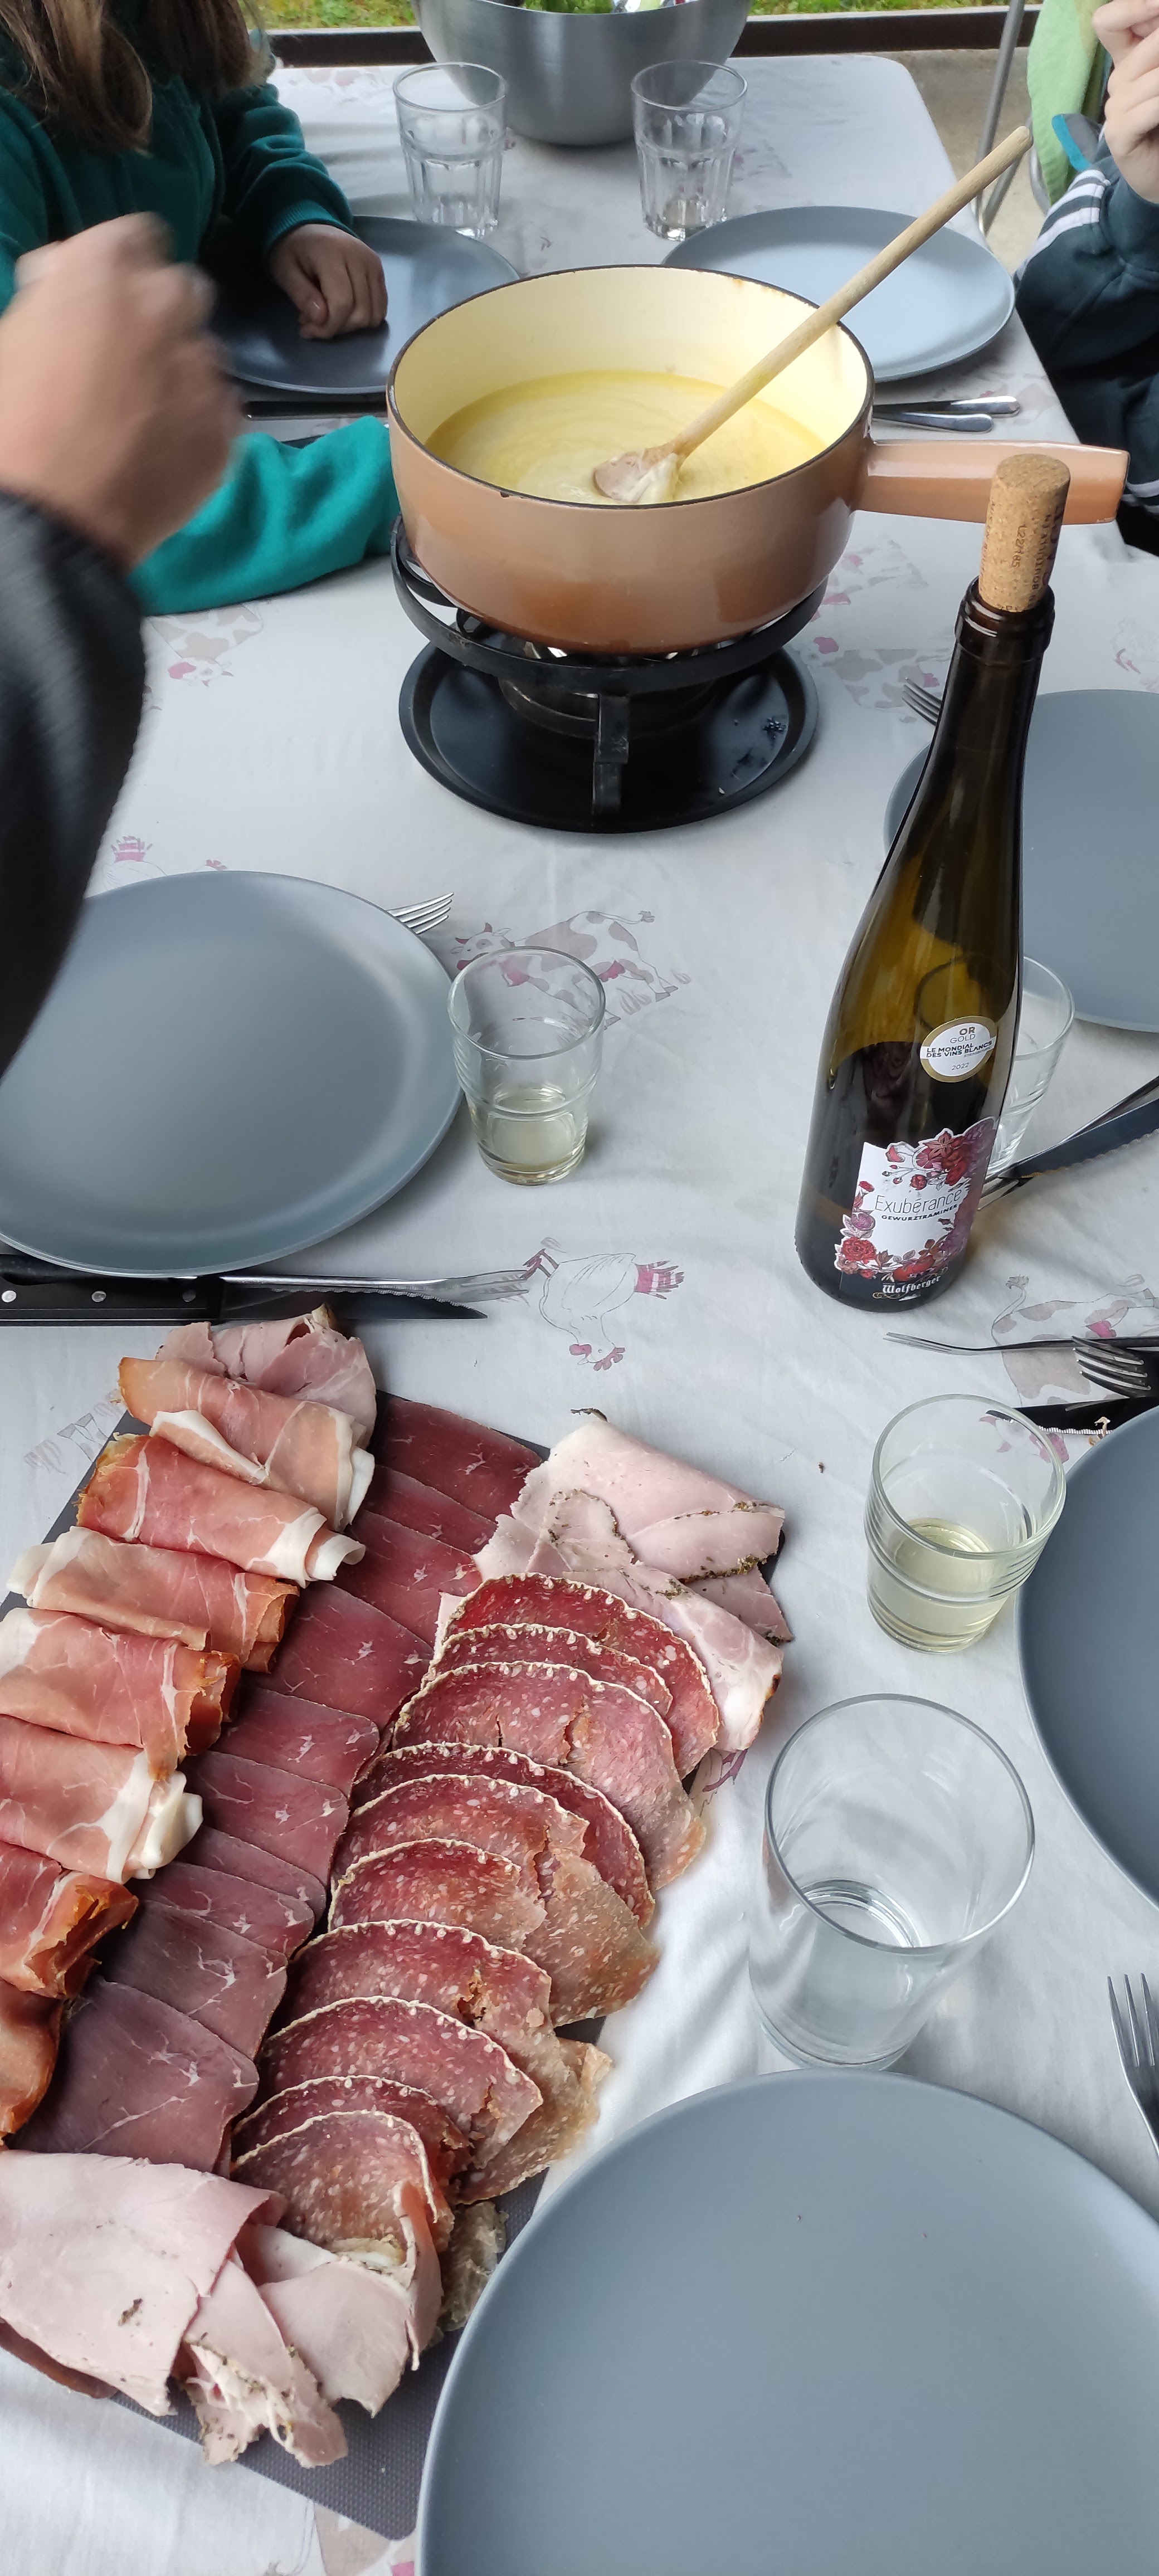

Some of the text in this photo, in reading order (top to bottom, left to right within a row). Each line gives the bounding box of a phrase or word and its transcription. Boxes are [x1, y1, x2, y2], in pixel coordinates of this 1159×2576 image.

[960, 1026, 975, 1036] OR
[950, 1034, 976, 1043] GOLD
[938, 1043, 974, 1052] MONDIAL
[964, 1040, 992, 1053] BLANCS
[875, 1189, 962, 1213] Exubérance
[882, 1203, 958, 1221] GEWURZTRAMINER
[882, 1275, 941, 1294] Wolfberger
